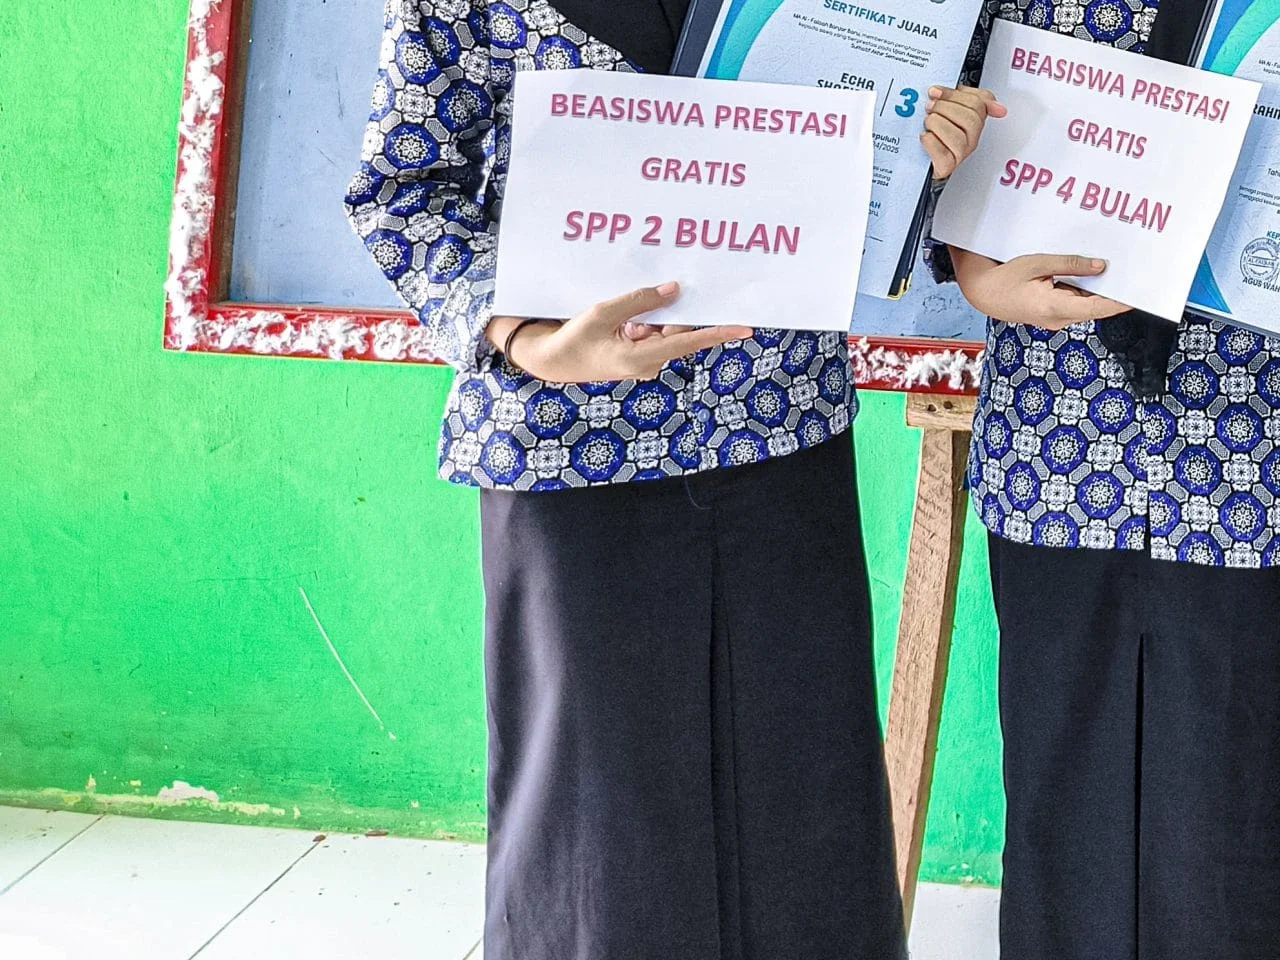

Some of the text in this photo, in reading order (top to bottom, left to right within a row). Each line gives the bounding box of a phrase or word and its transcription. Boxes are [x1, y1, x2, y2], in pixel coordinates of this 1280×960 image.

[896, 18, 939, 38] JUARA
[840, 72, 876, 90] ECHA
[1011, 47, 1230, 124] BEASISWA PRESTASI
[550, 93, 847, 139] BEASISWA PRESTASI
[895, 88, 919, 118] 3
[871, 130, 901, 145] epuluh)
[1067, 118, 1148, 159] GRATIS
[641, 157, 747, 186] GRATIS
[1000, 159, 1171, 233] SPP 4 BULAN
[563, 210, 800, 255] SPP 2 BULAN
[1242, 275, 1262, 287] AGUS
